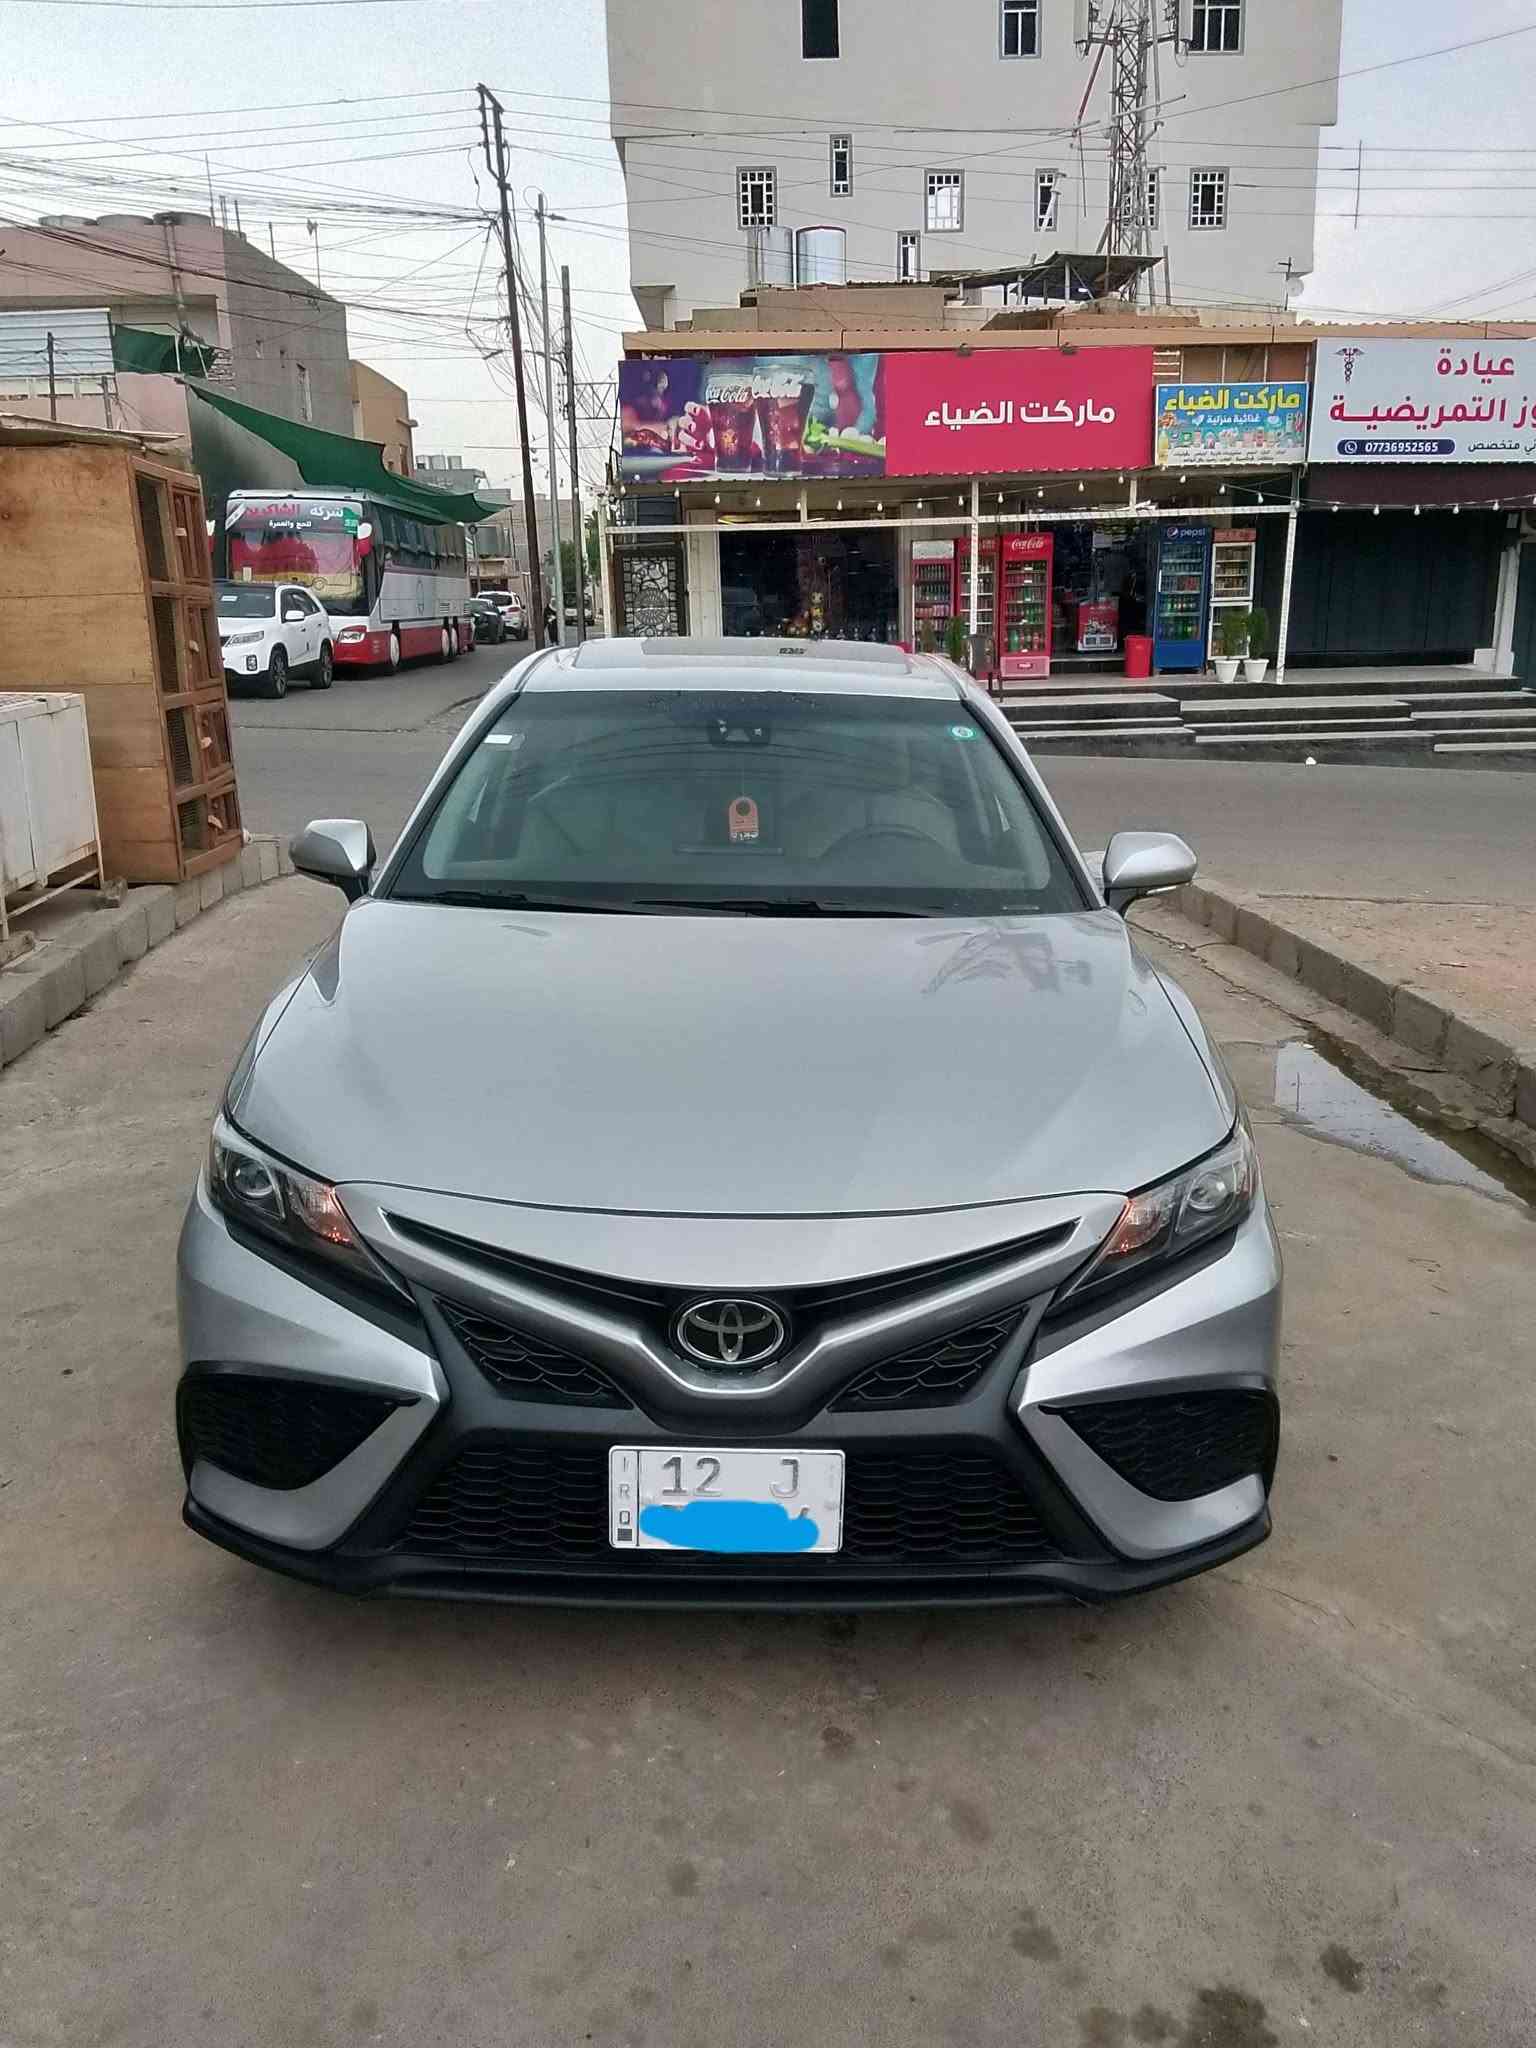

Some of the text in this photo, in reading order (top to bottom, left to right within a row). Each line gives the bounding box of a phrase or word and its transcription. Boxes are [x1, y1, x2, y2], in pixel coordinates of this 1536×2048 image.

[1437, 348, 1515, 384] عيادة
[924, 399, 1116, 431] ماركت الضياء
[1165, 388, 1300, 416] ماركت الضياء
[1329, 395, 1507, 431] التمريضية
[1207, 414, 1232, 426] منزلية
[1365, 441, 1439, 453] 07736952565
[1467, 440, 1520, 453] متخصص
[1180, 527, 1206, 538] pepsi
[660, 1455, 800, 1498] 12 J
